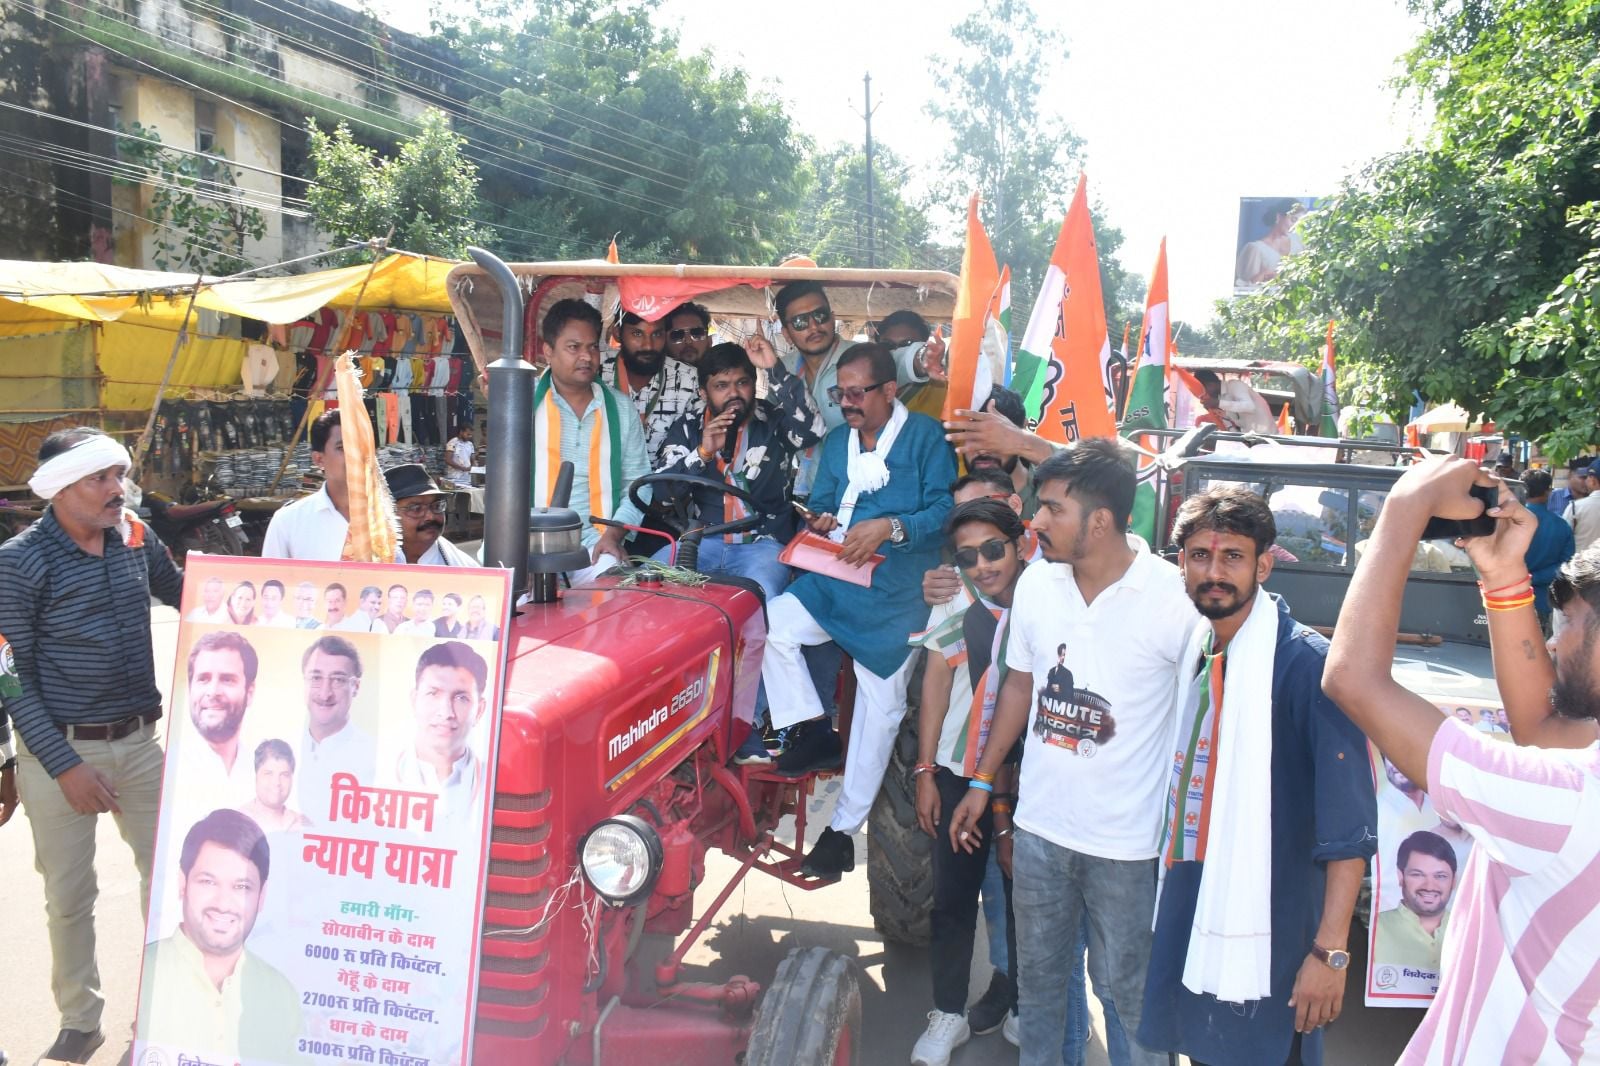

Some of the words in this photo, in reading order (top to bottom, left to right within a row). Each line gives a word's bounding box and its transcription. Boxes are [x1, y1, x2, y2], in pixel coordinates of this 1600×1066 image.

[1041, 695, 1104, 725] NMUTE
[608, 705, 668, 762] Mahindra
[329, 772, 439, 832] किसान
[303, 833, 379, 879] न्याय
[385, 842, 458, 889] यात्रा
[339, 901, 381, 918] हमारी
[321, 919, 386, 943] सोयाबीन
[388, 927, 404, 944] के
[407, 933, 436, 949] दाम
[305, 944, 339, 961] 6000
[360, 949, 388, 967] प्रति
[363, 972, 378, 989] के
[382, 978, 411, 994] दाम
[352, 996, 381, 1015] प्रति
[329, 1019, 358, 1035] धान
[361, 1020, 377, 1037] के
[380, 1026, 409, 1043] दाम
[348, 1044, 376, 1063] प्रति
